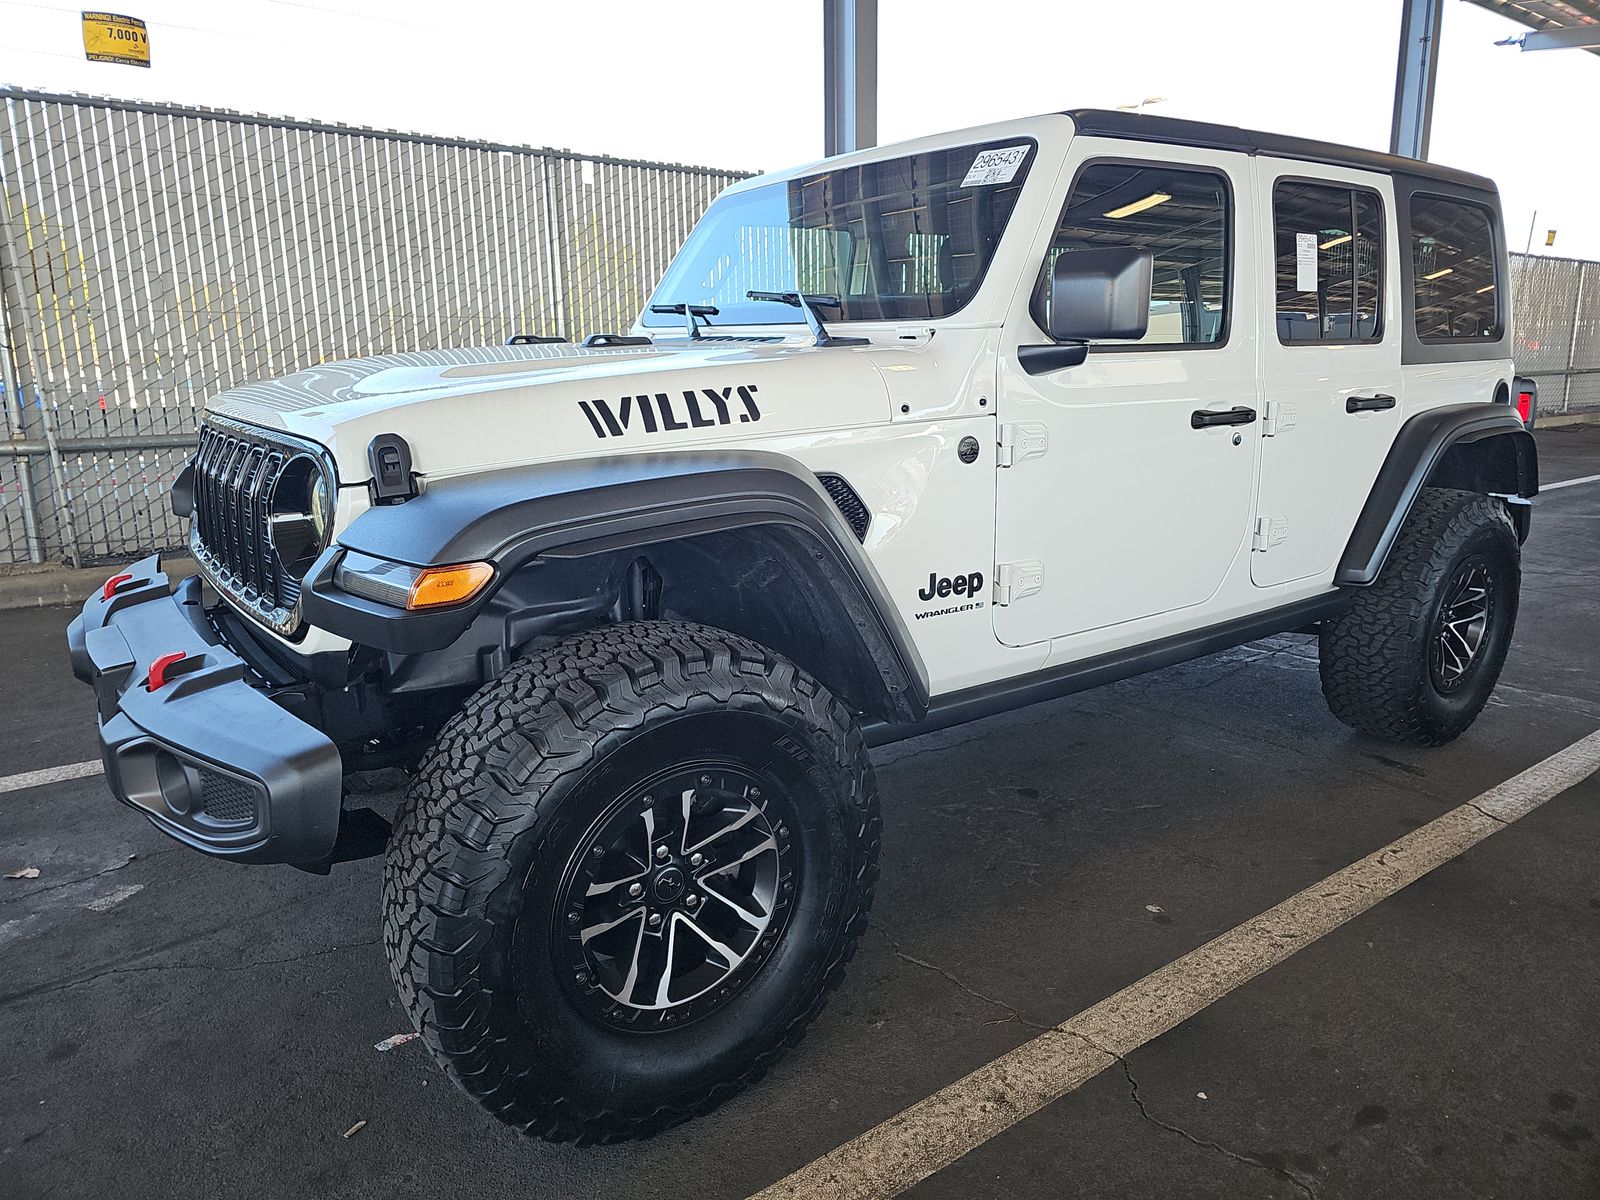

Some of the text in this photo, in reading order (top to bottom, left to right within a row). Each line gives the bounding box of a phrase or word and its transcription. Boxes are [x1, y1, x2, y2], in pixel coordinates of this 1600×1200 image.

[107, 28, 146, 44] 7,000 V
[973, 149, 1027, 169] 2965431
[577, 385, 761, 438] WILLYS
[918, 572, 984, 601] Jeep
[915, 604, 974, 620] WRANGLER
